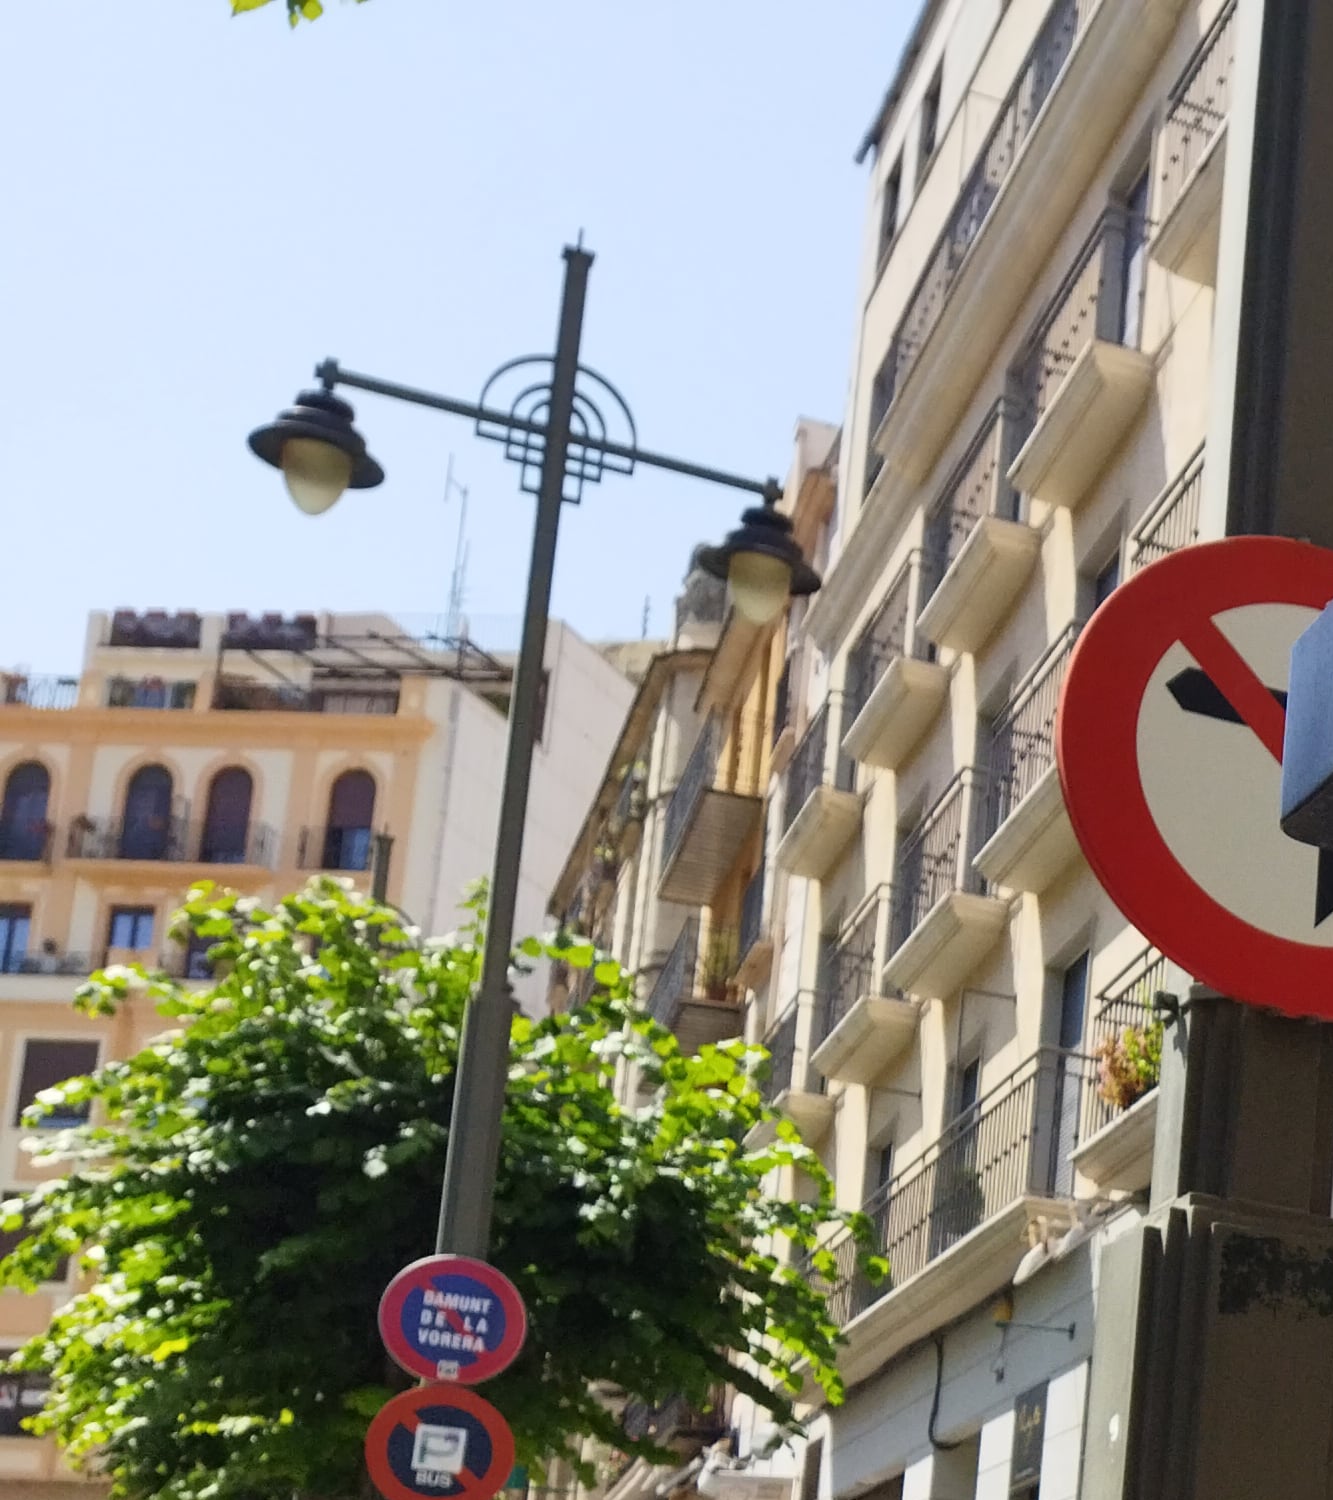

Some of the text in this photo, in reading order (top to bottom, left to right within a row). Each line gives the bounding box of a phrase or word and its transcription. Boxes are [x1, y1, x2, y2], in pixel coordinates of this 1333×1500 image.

[423, 1289, 492, 1315] DAMUNT
[420, 1308, 488, 1334] DE LA
[418, 1327, 485, 1353] VORERA
